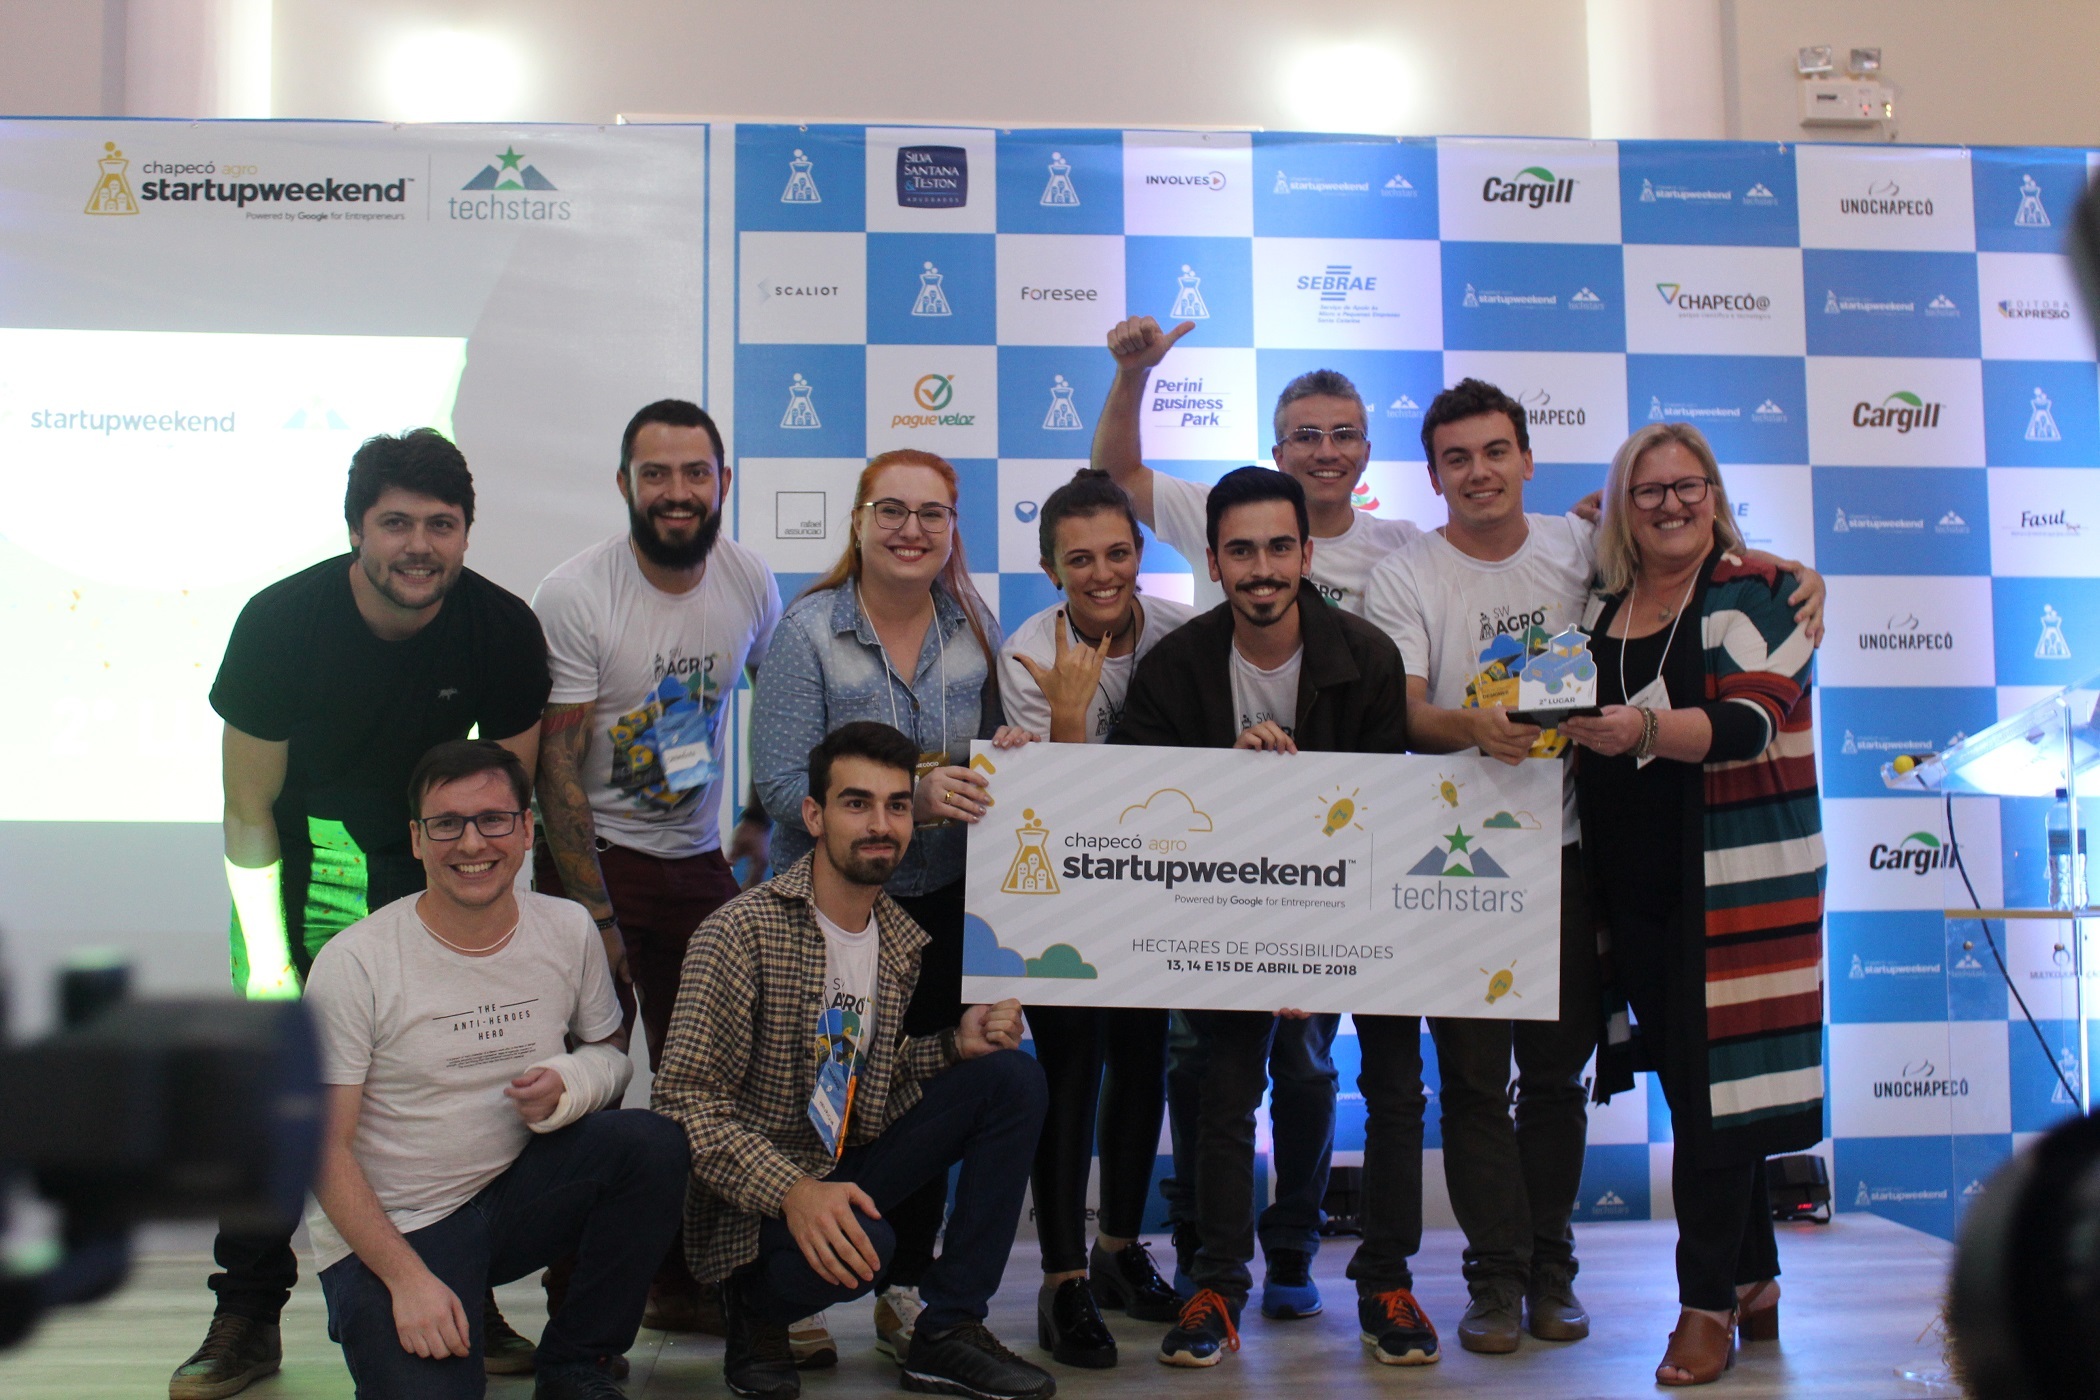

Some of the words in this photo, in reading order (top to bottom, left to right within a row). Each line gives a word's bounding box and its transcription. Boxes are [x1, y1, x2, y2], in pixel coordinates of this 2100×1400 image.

[143, 160, 216, 177] chapecó
[221, 164, 258, 178] agro
[904, 164, 960, 176] SANTANA
[1145, 175, 1210, 186] INVOLVES
[1483, 177, 1575, 209] Cargill
[448, 193, 572, 221] techstars
[1840, 198, 1934, 216] UNOCHAPECÓ
[246, 211, 283, 221] Powered
[285, 211, 296, 222] by
[298, 211, 329, 222] Google
[331, 211, 343, 221] for
[345, 212, 405, 222] Entrepreneurs
[774, 286, 839, 297] SCALIOT
[1296, 276, 1377, 290] SEBRAE
[1021, 285, 1098, 302] Foresee
[2008, 308, 2070, 319] EXPRESSO
[1154, 378, 1203, 394] Perini
[1152, 397, 1224, 413] Business
[30, 408, 235, 436] startupweekend
[1181, 412, 1220, 427] Park
[1852, 402, 1941, 434] Cargill
[2021, 509, 2065, 528] Fasul
[1493, 604, 1511, 620] SW
[1495, 610, 1546, 636] AGRO
[1859, 631, 1954, 651] UNOCHAPECÓ
[666, 656, 715, 676] AGRO
[1548, 696, 1576, 705] LUGAR
[1064, 833, 1143, 851] chapecó
[1148, 836, 1187, 854] agro
[1174, 894, 1214, 905] Powered
[1216, 895, 1228, 906] by
[1230, 895, 1263, 908] Google
[1266, 896, 1278, 906] for
[1281, 897, 1346, 909] Entrepreneurs
[1392, 880, 1525, 914] techstars
[1132, 938, 1221, 954] HECTARES
[1226, 940, 1249, 955] DE
[1255, 942, 1394, 959] POSSIBILIDADES
[1166, 959, 1185, 972] 13,
[1187, 959, 1202, 971] 14
[1204, 960, 1214, 972] E
[1216, 960, 1231, 972] 15
[1234, 961, 1253, 973] DE
[1256, 962, 1300, 975] ABRIL
[1302, 963, 1322, 975] DE
[1325, 964, 1358, 976] 2018
[478, 1003, 497, 1014] THE
[453, 1009, 532, 1032] ANTI-HEROES
[478, 1028, 505, 1041] HERO
